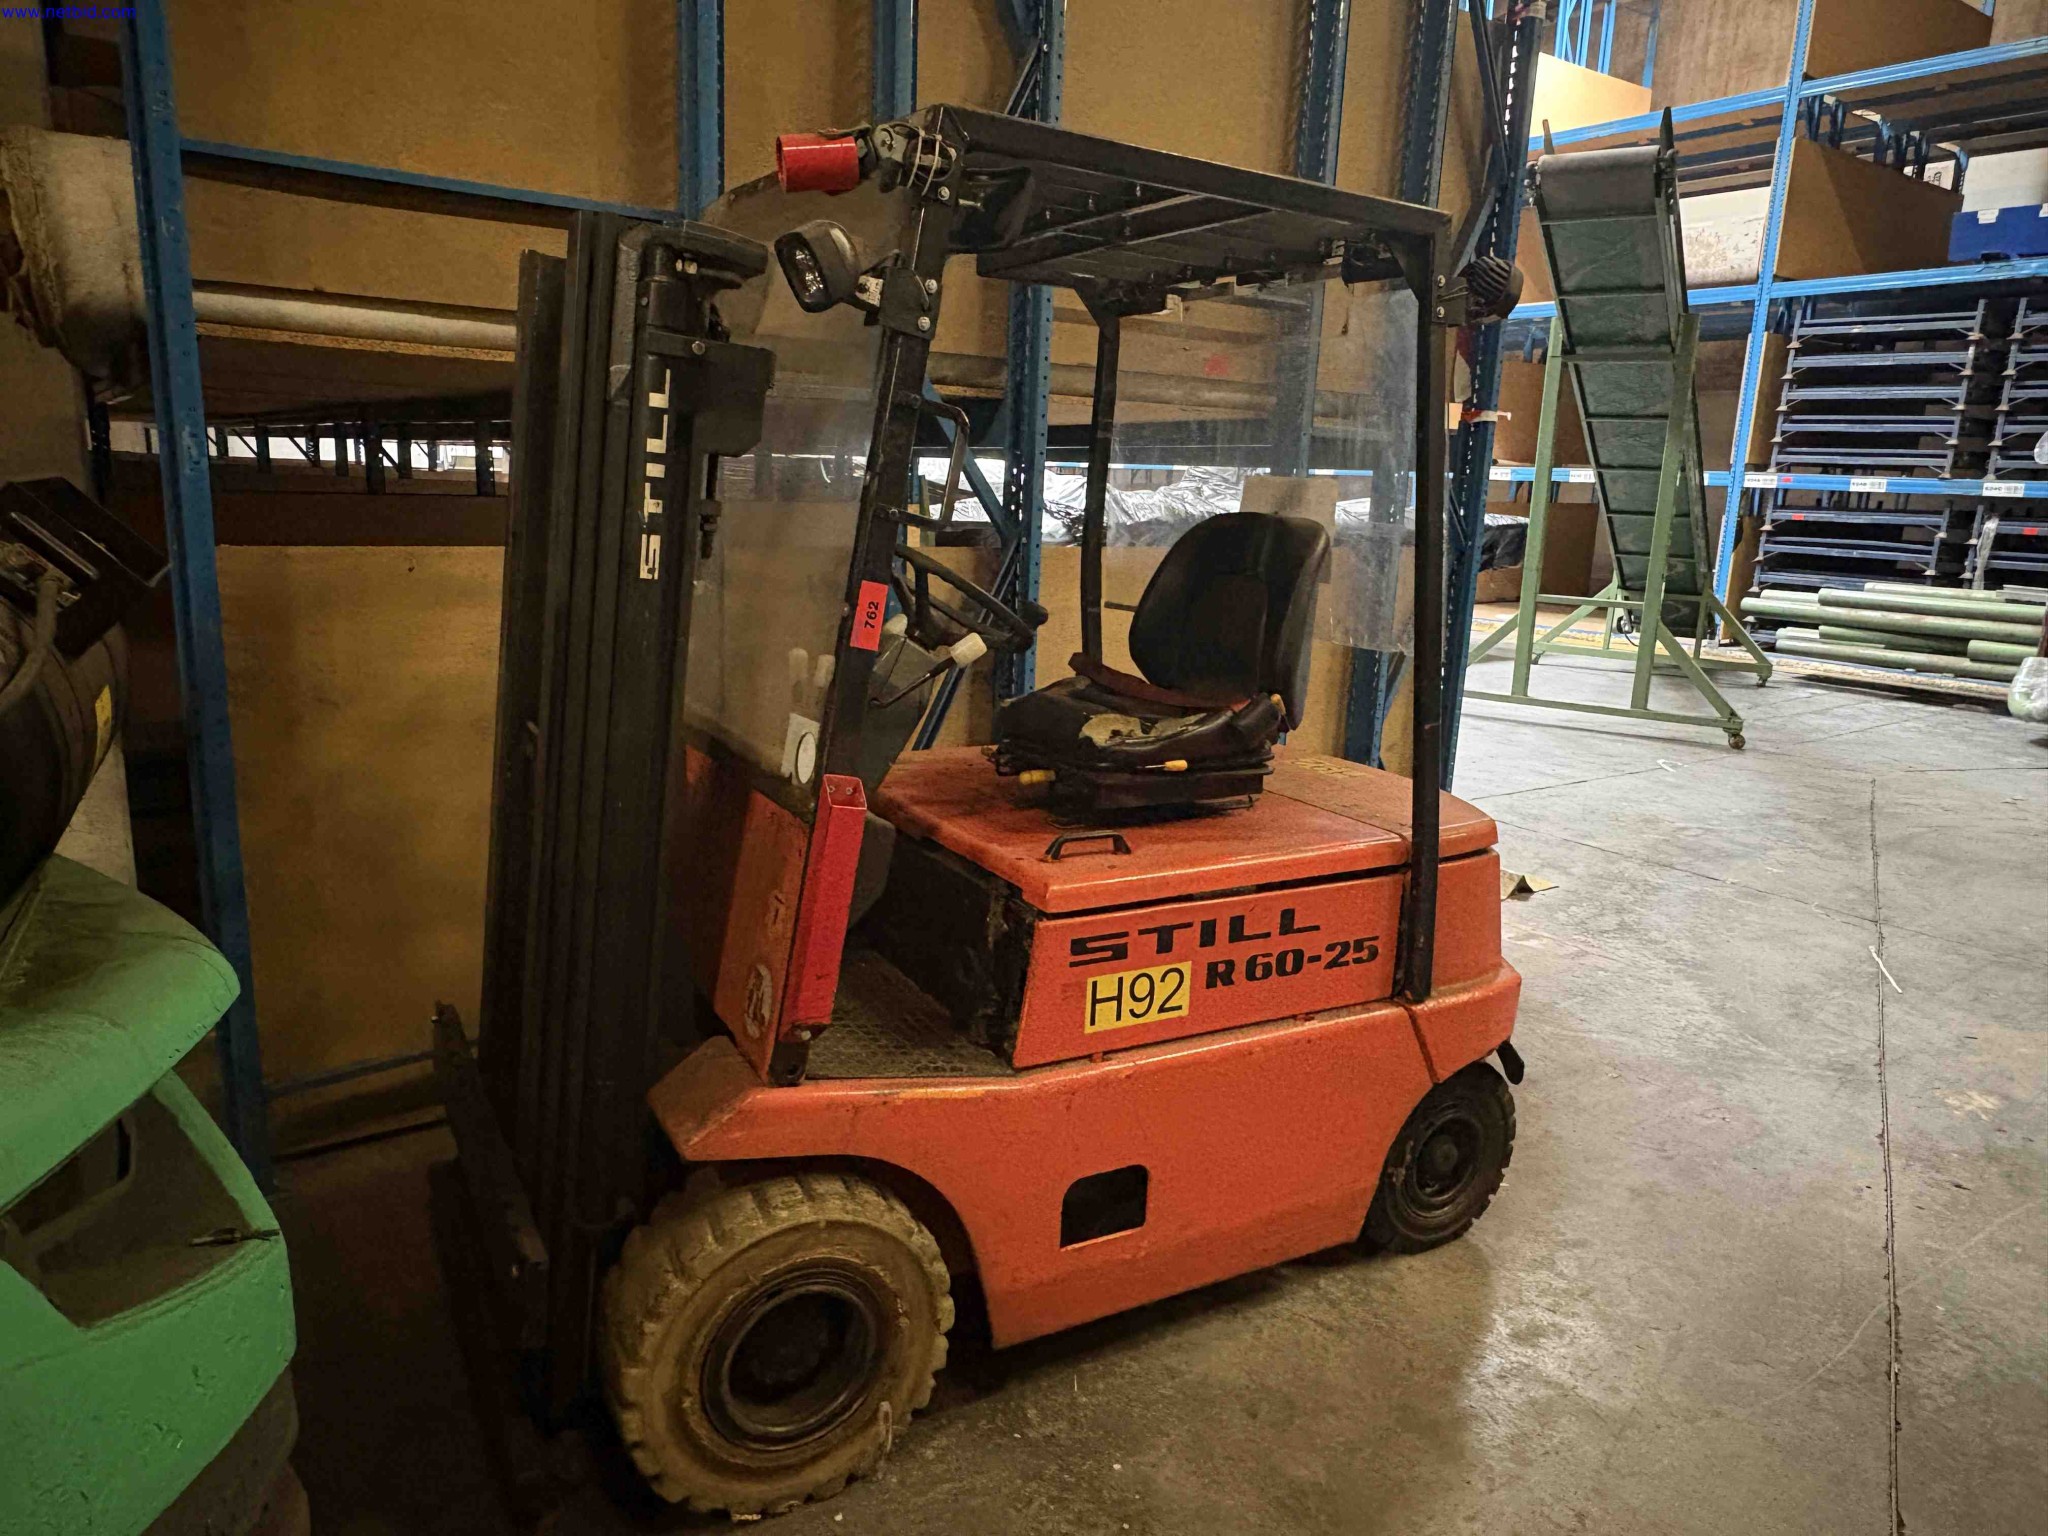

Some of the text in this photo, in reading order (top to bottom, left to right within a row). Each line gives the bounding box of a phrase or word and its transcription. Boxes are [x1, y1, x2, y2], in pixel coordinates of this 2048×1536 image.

[639, 368, 671, 580] STILL
[864, 601, 879, 629] 762
[1069, 908, 1321, 967] STILL
[1205, 936, 1379, 989] R 60-25
[1089, 967, 1186, 1026] H92
